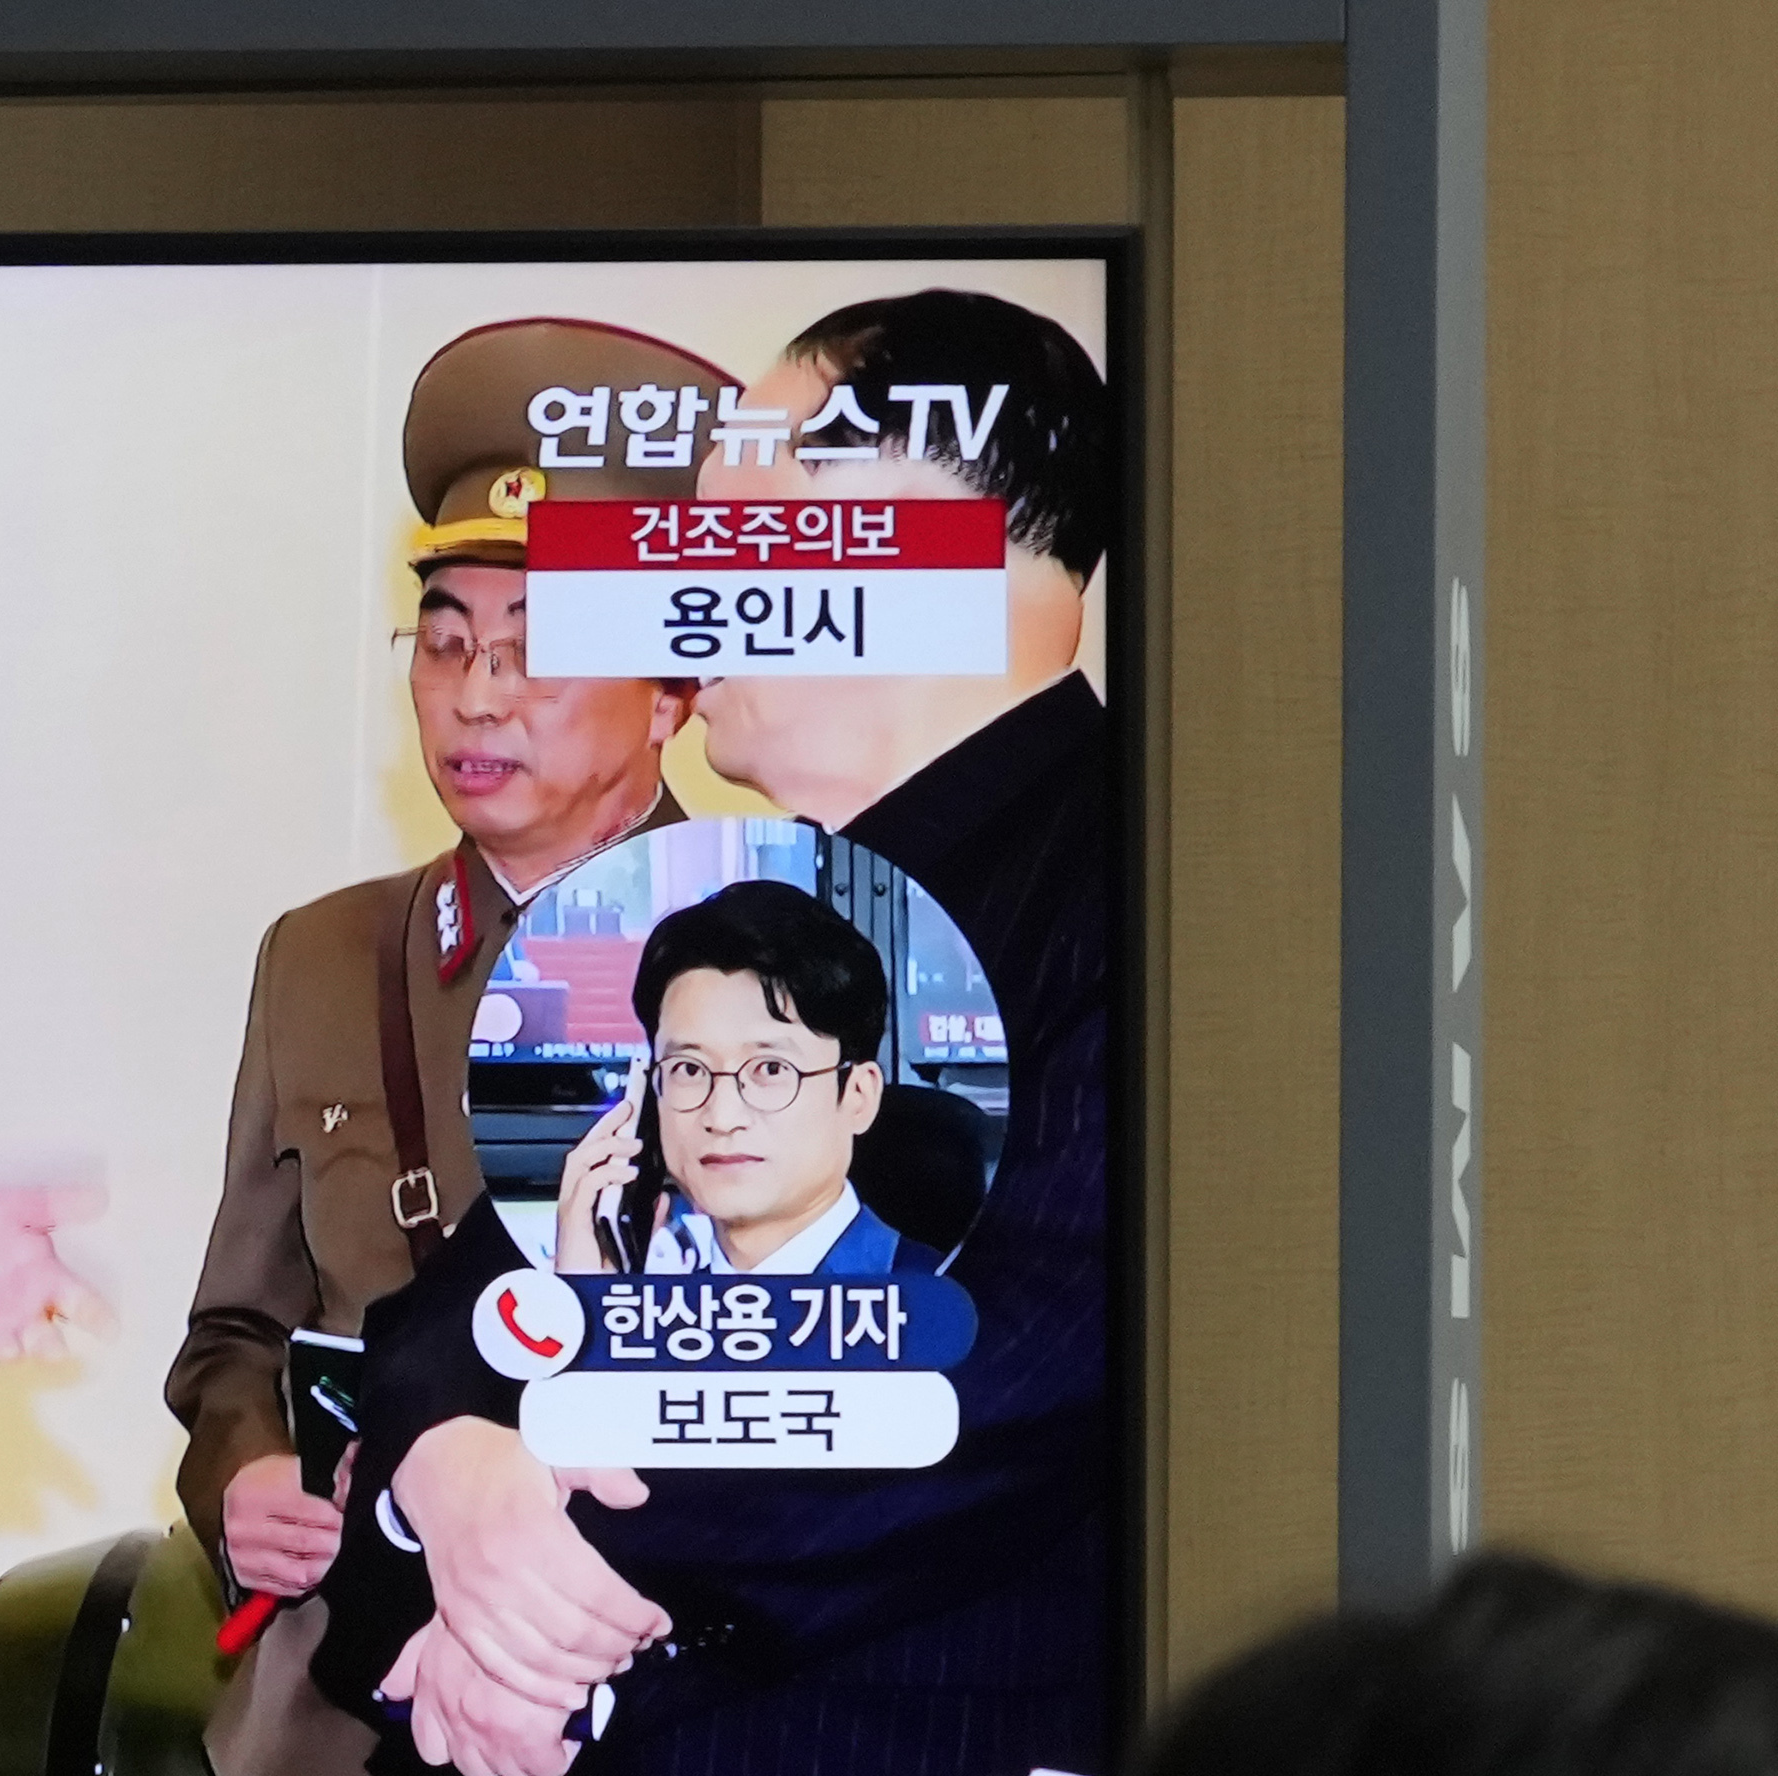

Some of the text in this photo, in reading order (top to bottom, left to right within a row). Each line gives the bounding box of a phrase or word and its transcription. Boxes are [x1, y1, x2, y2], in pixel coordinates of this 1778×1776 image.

[527, 383, 1010, 469] 연합뉴스TV
[630, 504, 901, 563] 건조주의보
[663, 586, 865, 659] 용인시
[601, 1284, 907, 1361] 한상용 기자
[652, 1389, 842, 1452] 보도국
